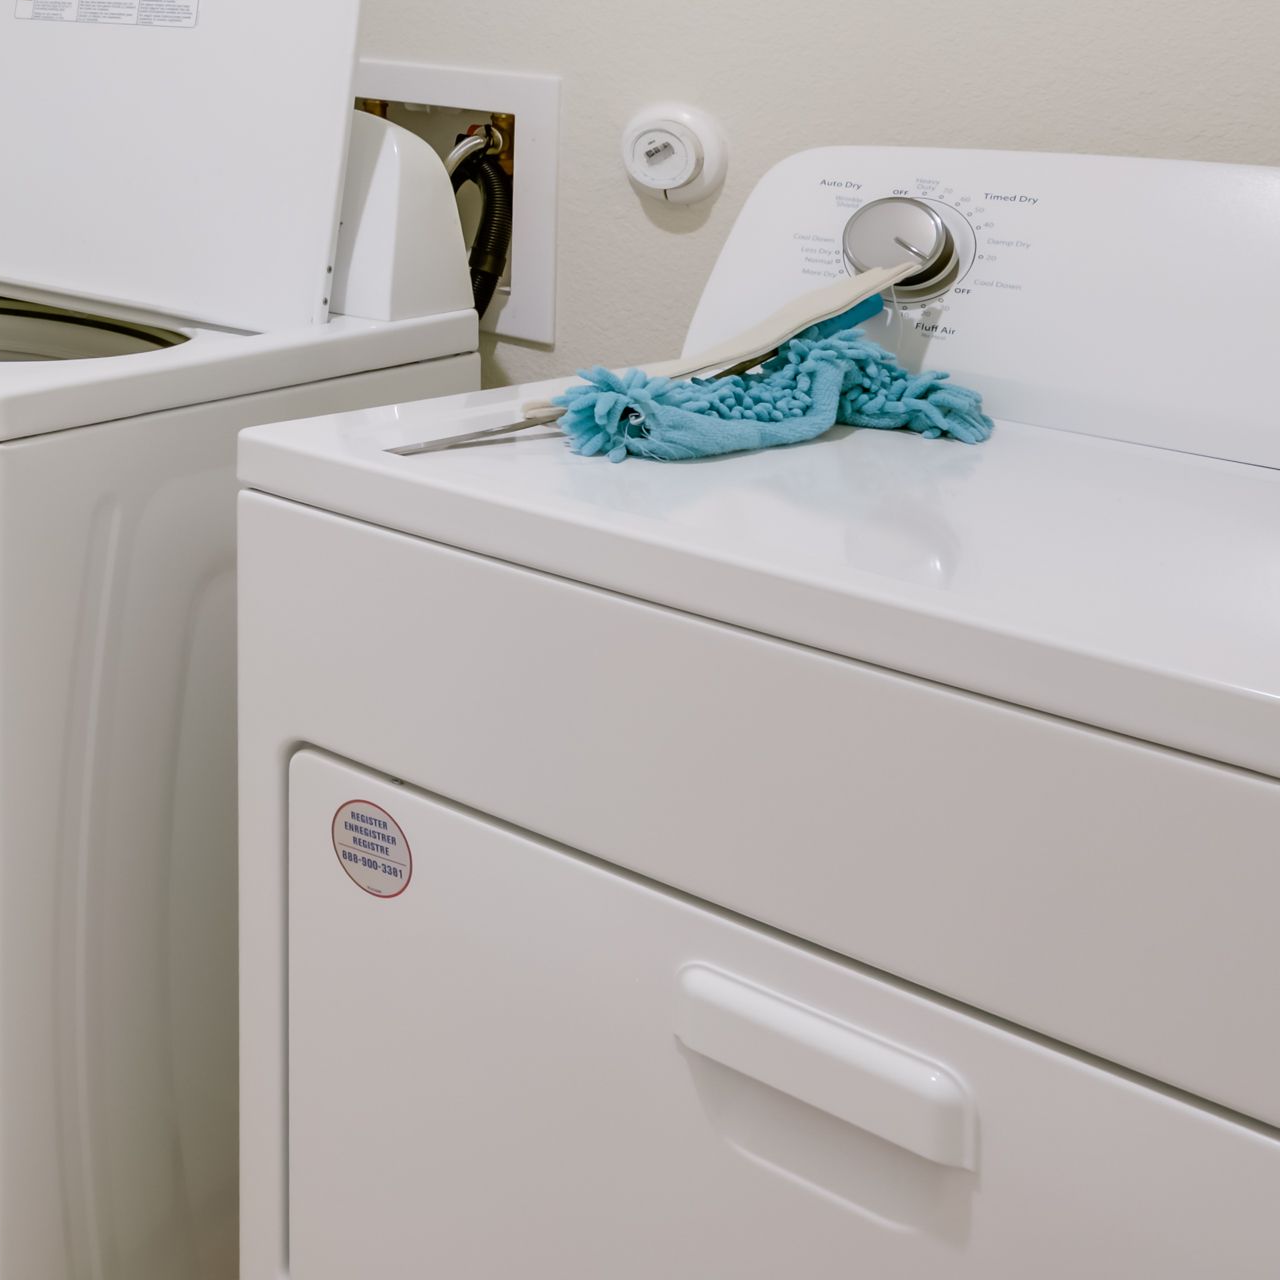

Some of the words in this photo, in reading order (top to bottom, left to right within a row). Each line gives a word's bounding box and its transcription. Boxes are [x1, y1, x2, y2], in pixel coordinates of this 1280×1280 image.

[820, 179, 843, 188] Auto
[845, 182, 863, 191] Dry
[984, 193, 1017, 202] Timed
[1019, 196, 1039, 205] Dry
[987, 238, 1014, 247] Damp
[1016, 240, 1032, 249] Dry
[819, 248, 833, 256] Dry
[974, 279, 995, 287] Cool
[954, 287, 971, 295] OFF
[915, 322, 939, 332] Fluff
[940, 326, 956, 335] Air
[350, 811, 388, 830] REGISTER
[344, 821, 397, 846] ENREGISTRER
[352, 836, 390, 856] REGISTRE
[342, 850, 403, 879] 888-900-3381
